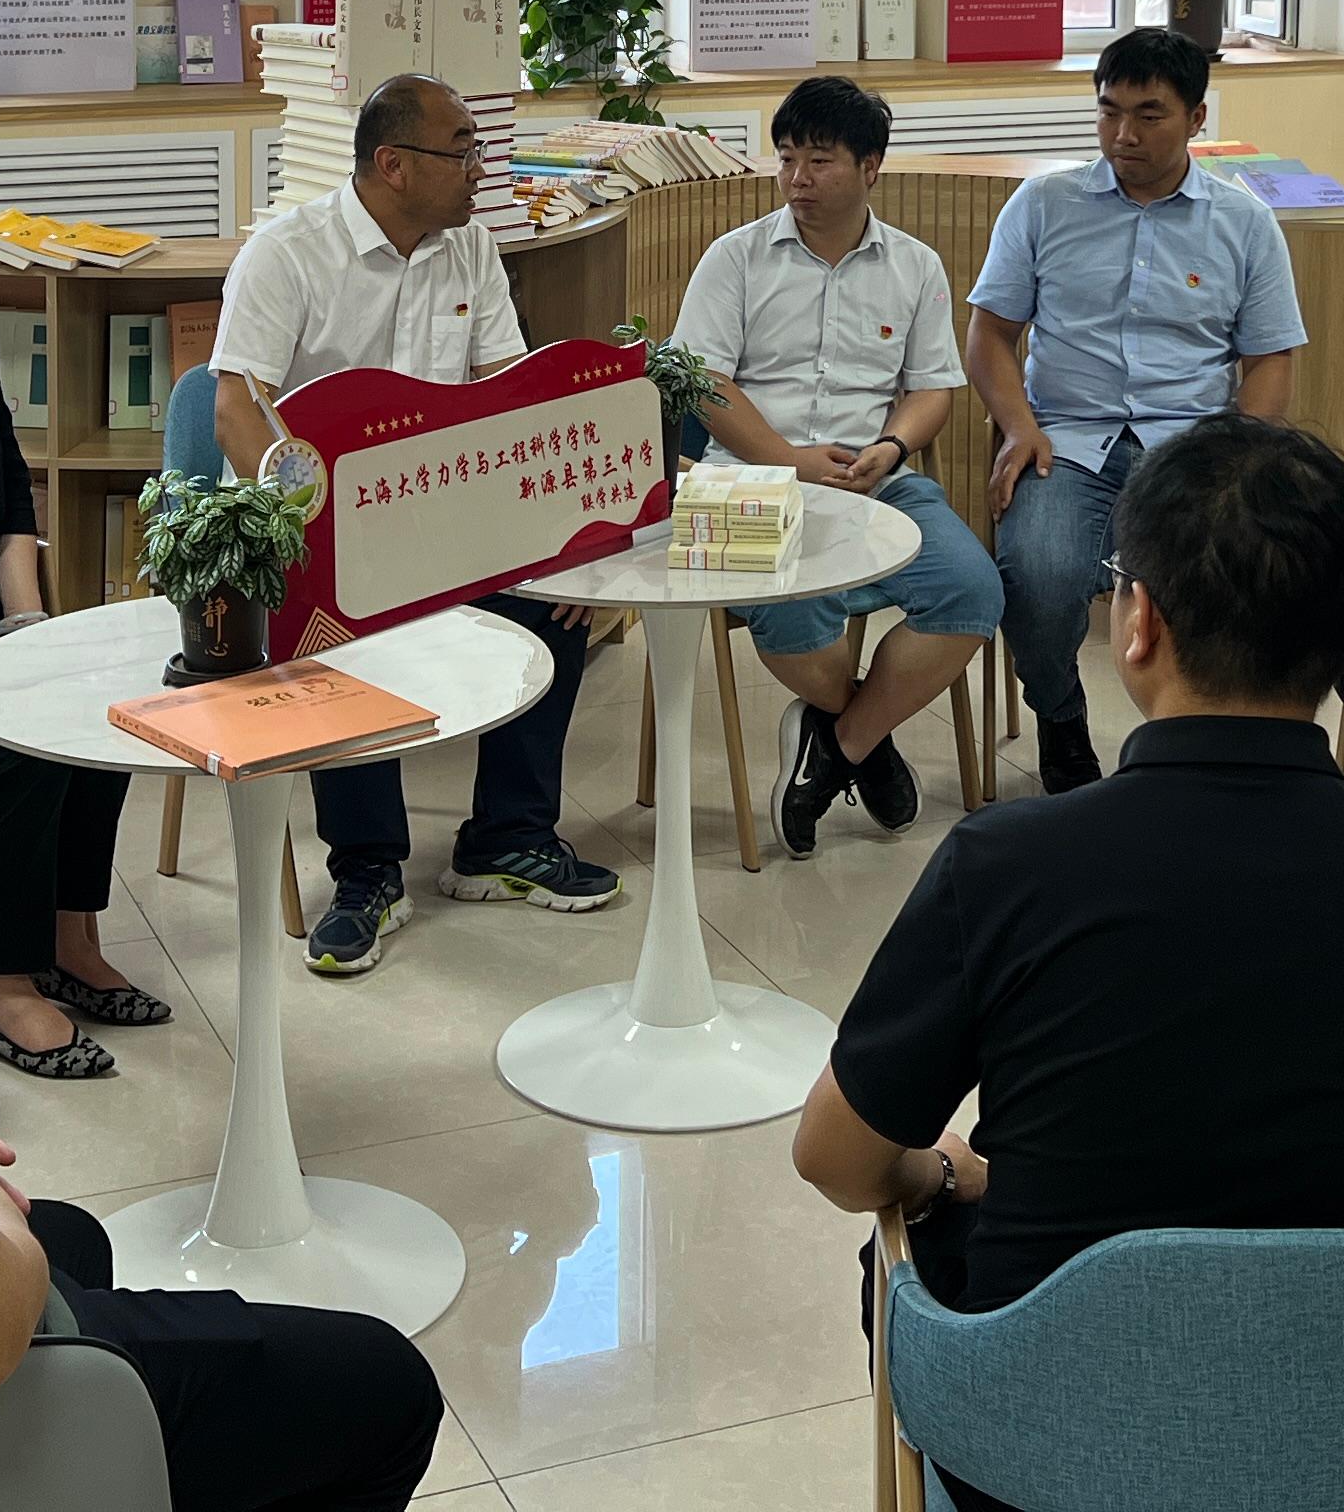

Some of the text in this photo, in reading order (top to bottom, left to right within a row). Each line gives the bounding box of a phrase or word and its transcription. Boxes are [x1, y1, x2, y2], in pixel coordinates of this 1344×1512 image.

[356, 420, 601, 509] 上海大学力学与工程科学学院
[519, 439, 654, 502] 新源县第三中学
[580, 478, 639, 513] 联学共建
[201, 596, 229, 657] 静心
